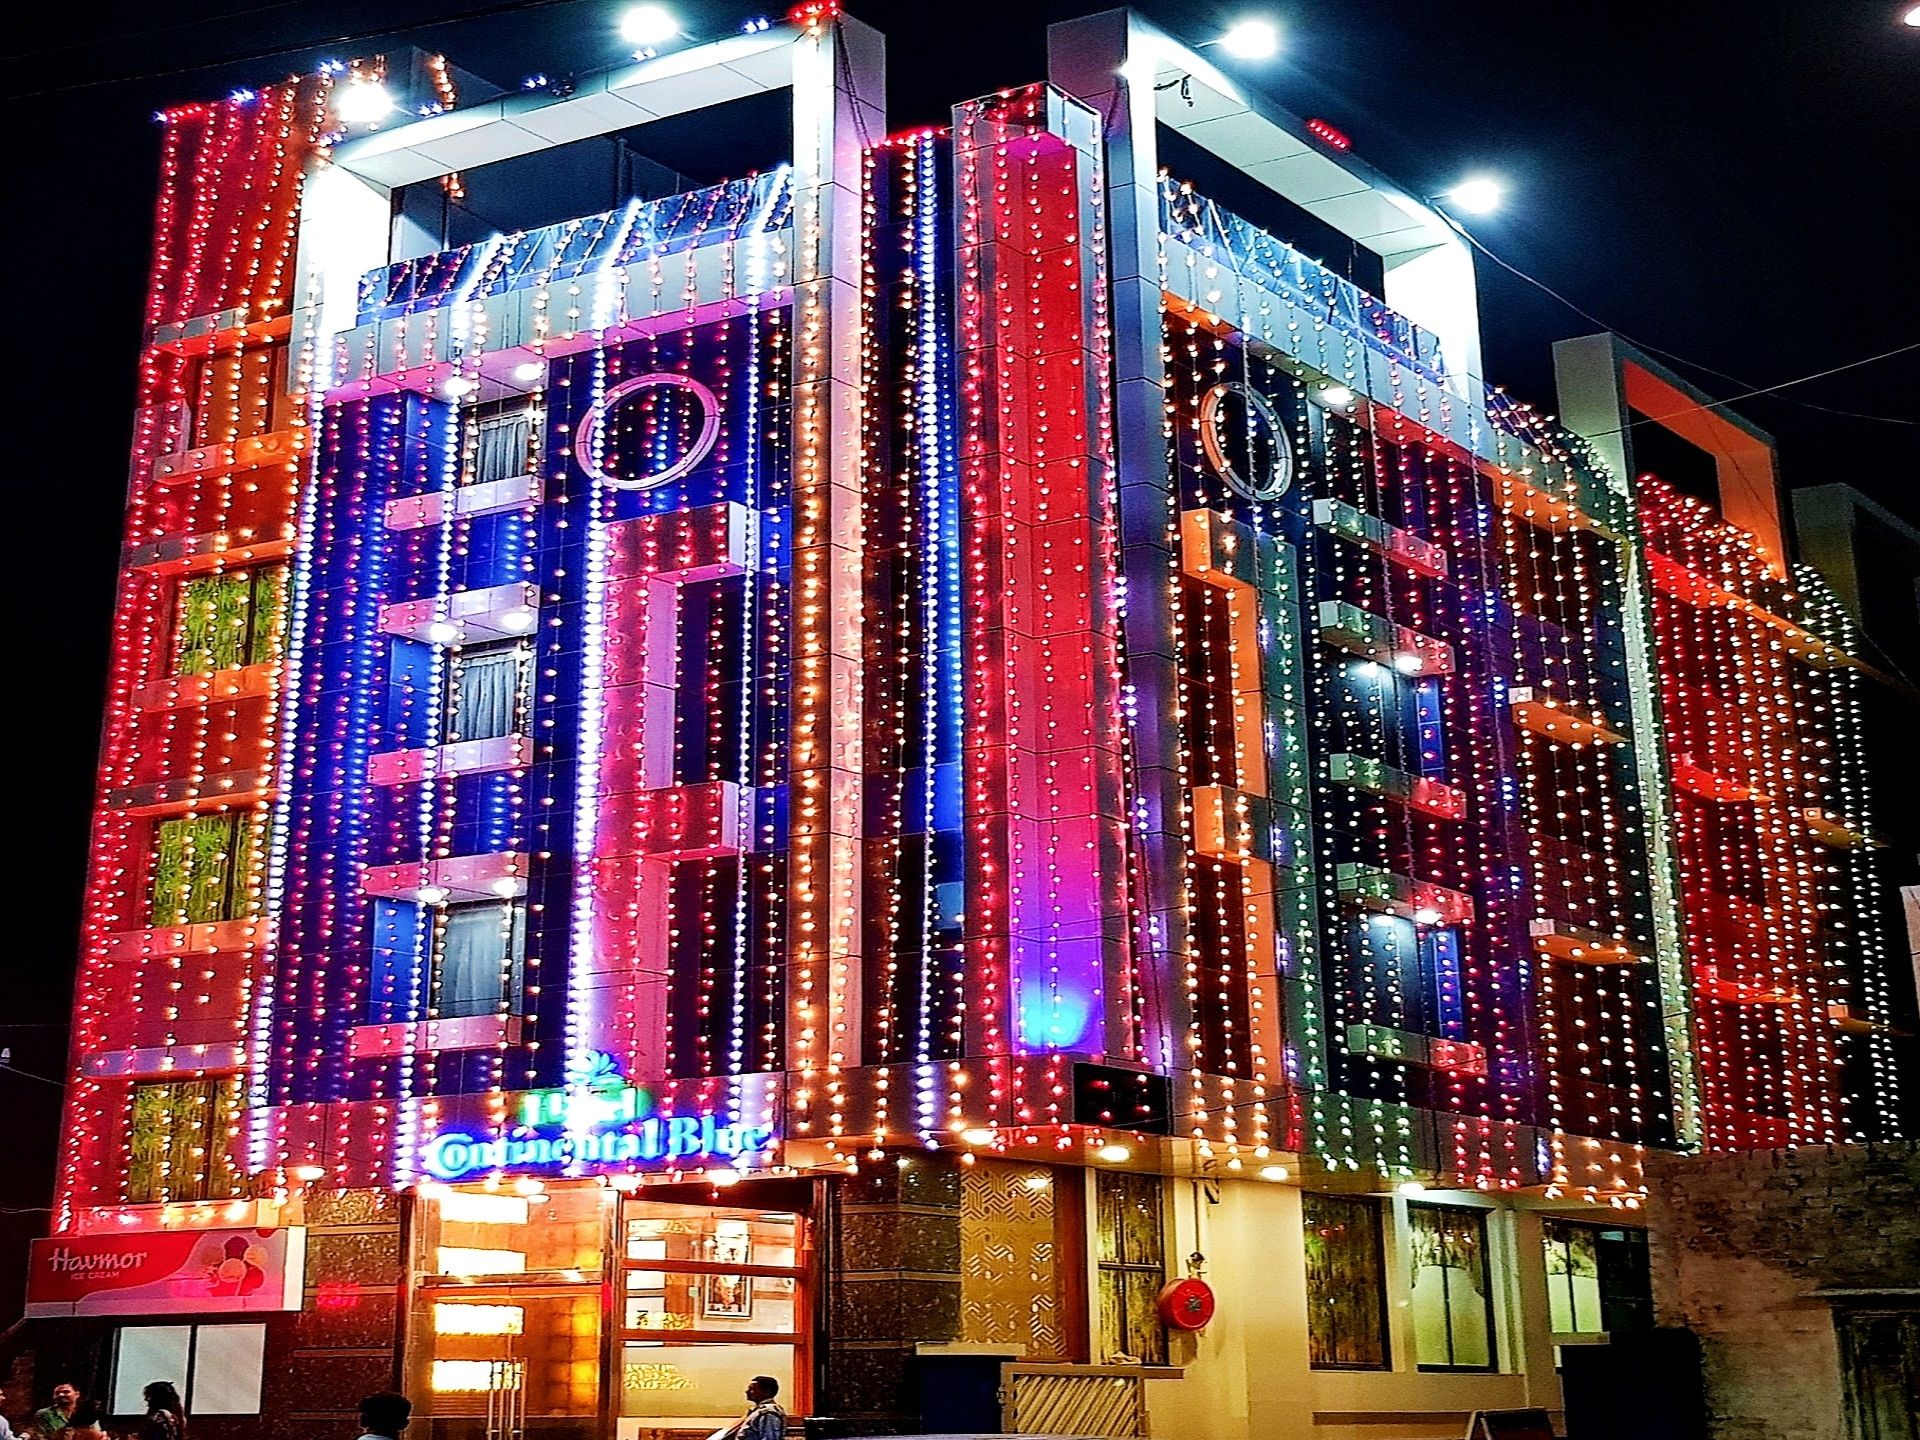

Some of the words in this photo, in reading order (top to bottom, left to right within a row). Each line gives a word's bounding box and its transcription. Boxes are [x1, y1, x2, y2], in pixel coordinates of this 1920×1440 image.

[424, 1116, 661, 1178] Continental
[668, 1115, 772, 1157] Blue
[48, 1247, 147, 1272] Havmor
[71, 1272, 85, 1280] ICE
[88, 1271, 119, 1279] CREAM
